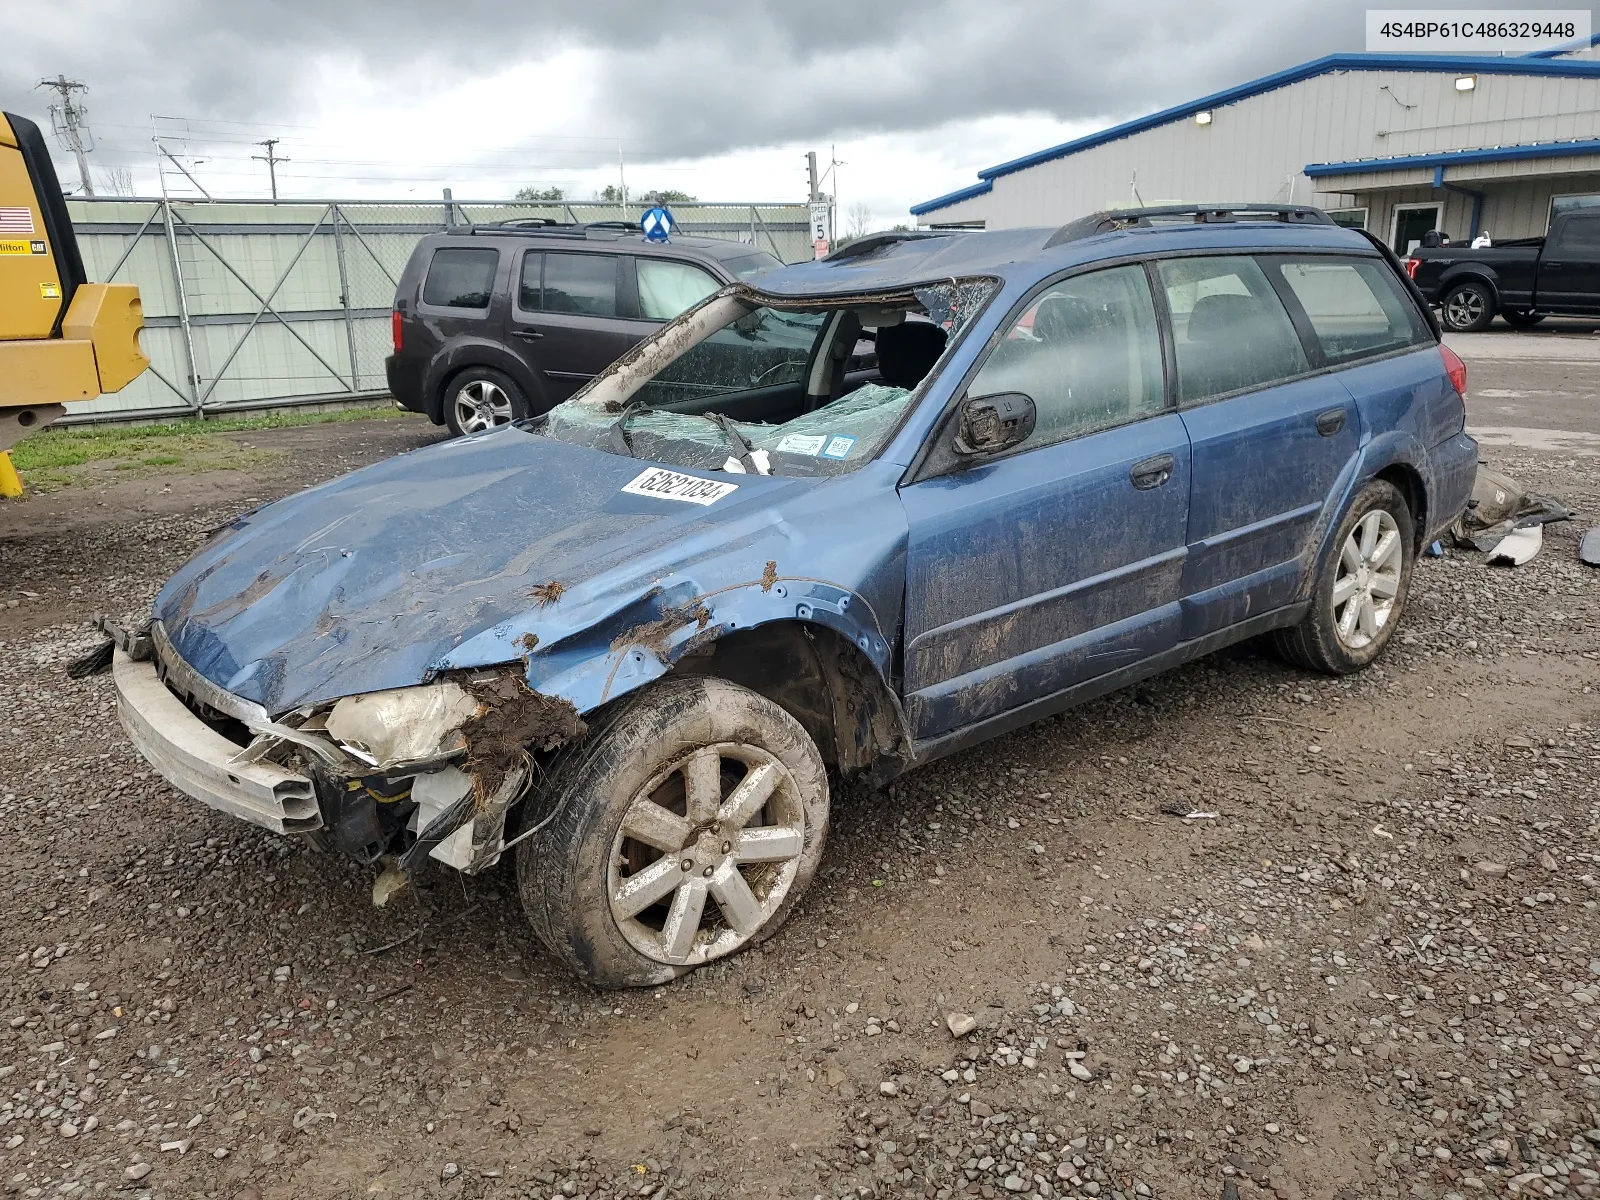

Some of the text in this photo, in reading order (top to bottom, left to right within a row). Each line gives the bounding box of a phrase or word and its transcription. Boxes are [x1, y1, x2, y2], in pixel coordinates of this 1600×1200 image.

[811, 205, 827, 214] SPEED
[813, 215, 826, 223] LIMIT
[817, 224, 825, 239] 5
[0, 243, 24, 252] ilton
[31, 243, 45, 252] CAT
